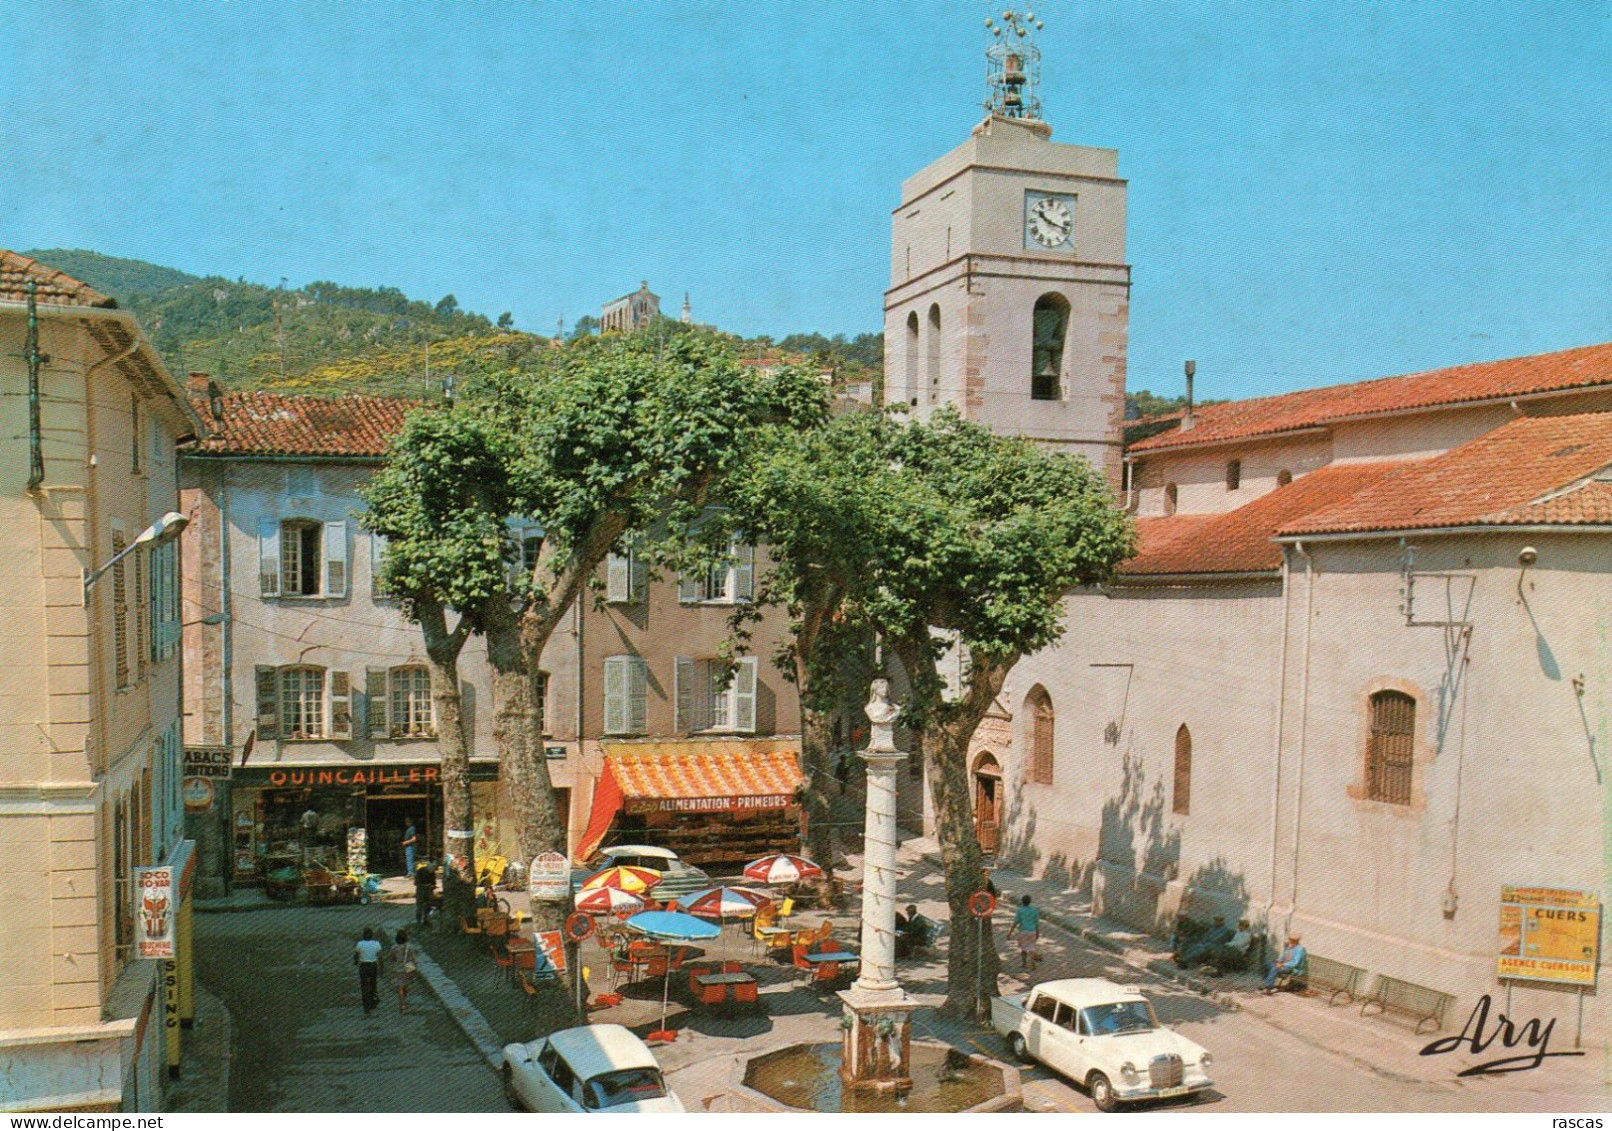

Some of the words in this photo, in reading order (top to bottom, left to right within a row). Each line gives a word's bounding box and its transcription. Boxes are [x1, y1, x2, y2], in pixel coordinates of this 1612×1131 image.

[659, 798, 730, 812] ALIMENTATION
[738, 796, 787, 808] PRIMEURS
[1535, 908, 1587, 922] CUERS
[1502, 958, 1537, 969] AGENCE
